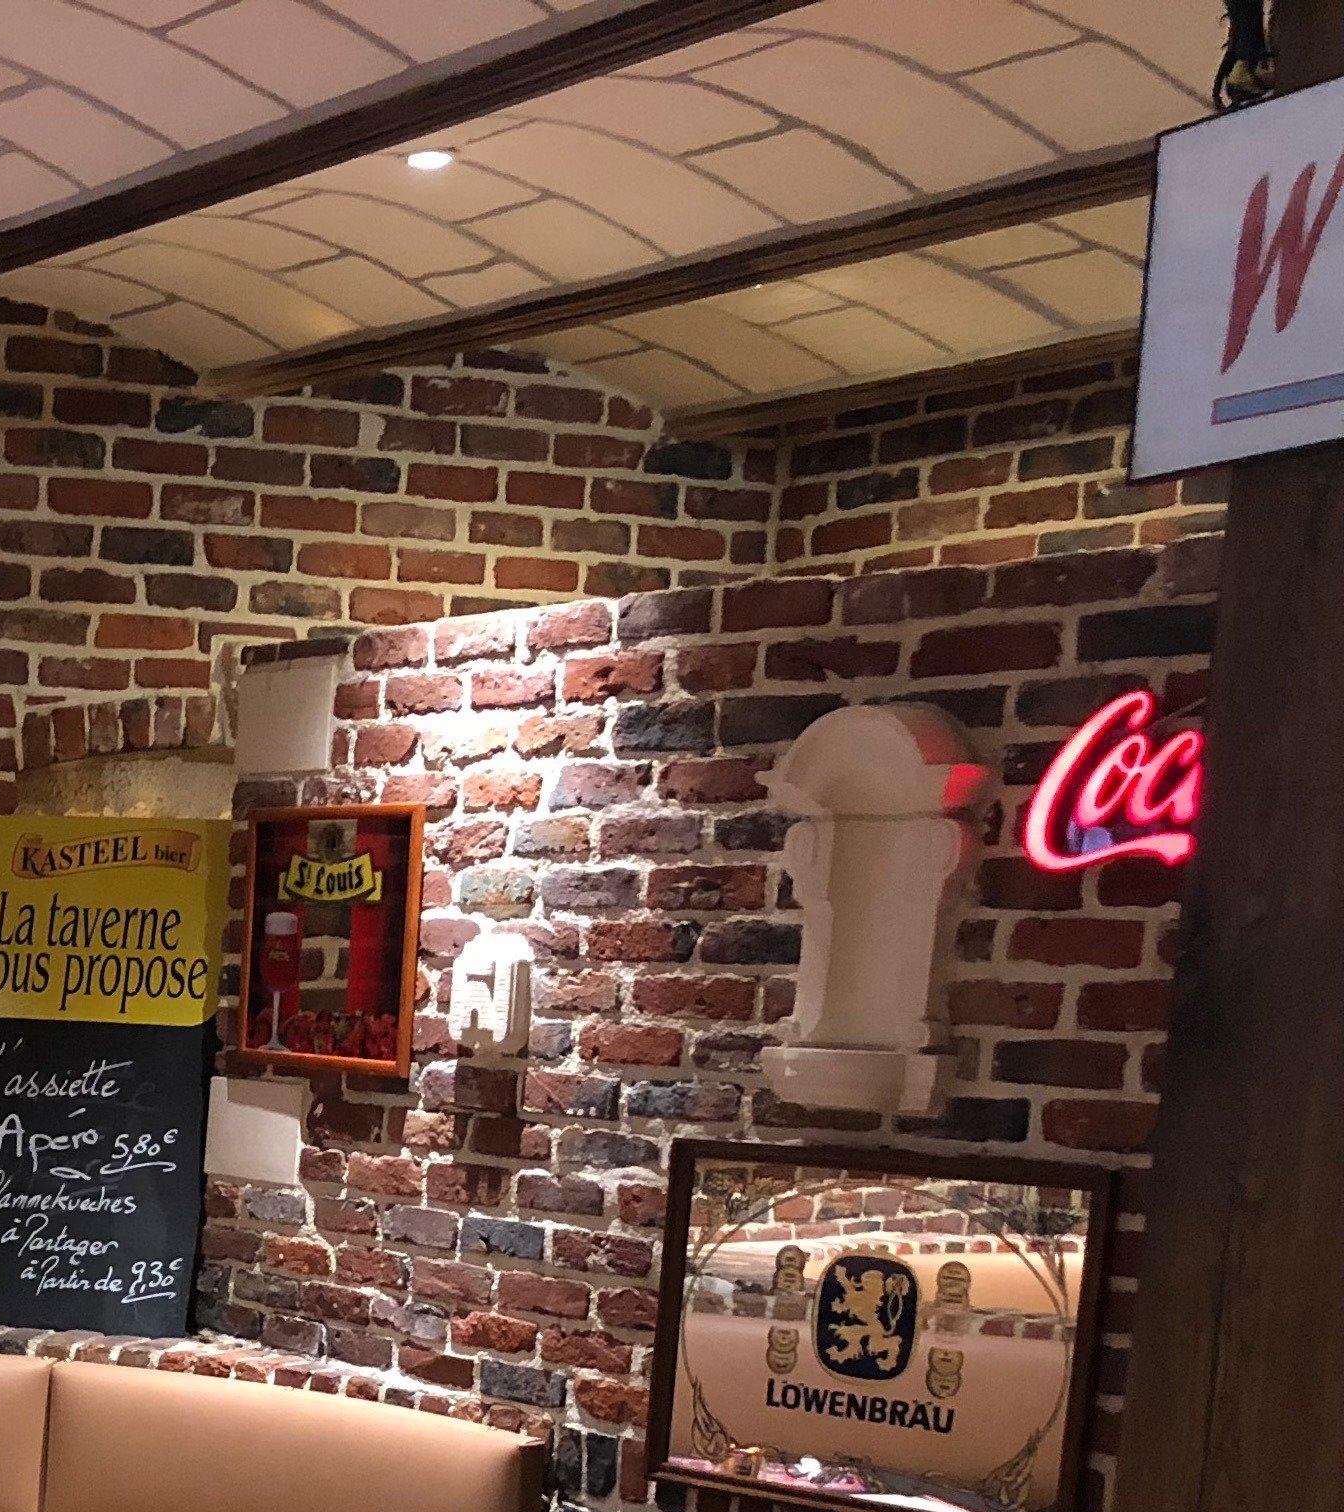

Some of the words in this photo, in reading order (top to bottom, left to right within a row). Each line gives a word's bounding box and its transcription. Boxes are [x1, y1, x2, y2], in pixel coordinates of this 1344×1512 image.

[21, 834, 148, 878] KASTEEL
[154, 844, 188, 864] bier
[314, 863, 364, 895] Louis
[47, 892, 182, 951] taverne
[58, 954, 208, 1013] propose
[94, 1266, 123, 1292] de
[765, 1377, 957, 1434] LÖWENBRÄU
